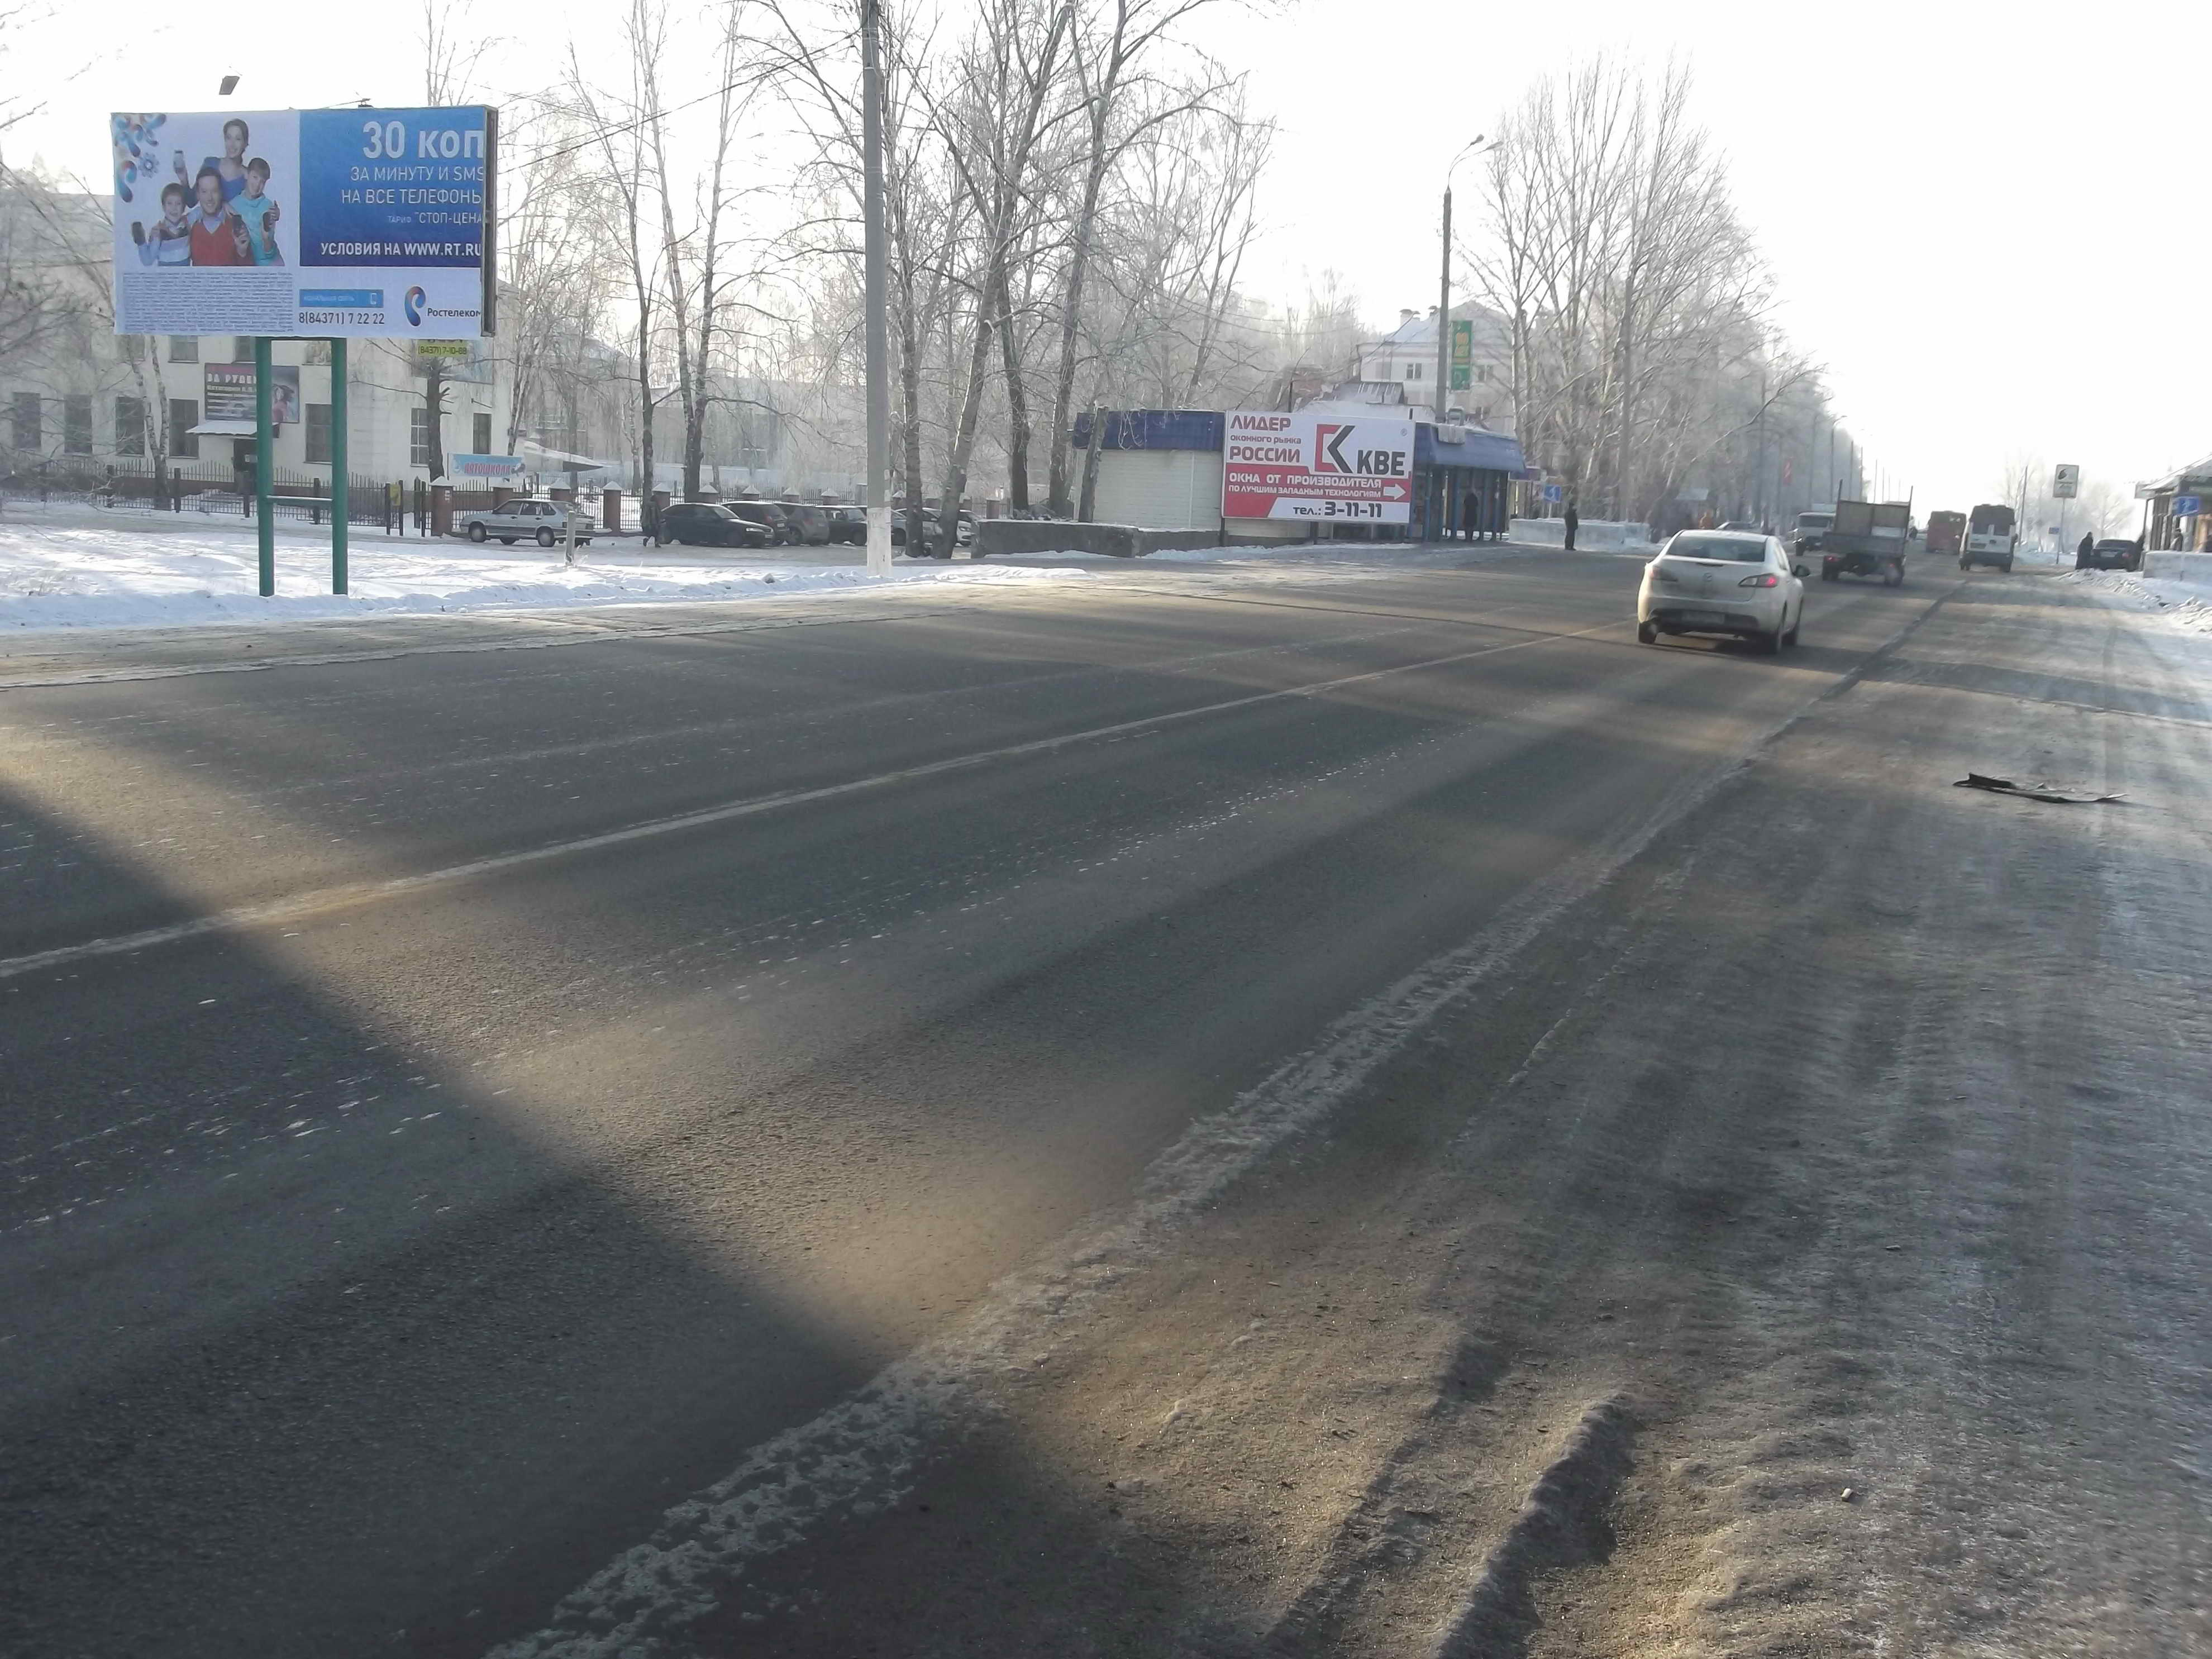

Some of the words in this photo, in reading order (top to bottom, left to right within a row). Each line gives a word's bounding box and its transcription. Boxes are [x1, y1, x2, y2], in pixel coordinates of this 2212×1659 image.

[363, 121, 405, 159] 30
[351, 166, 369, 181] ЗА
[374, 166, 433, 181] МИНУТУ
[439, 167, 448, 180] И
[453, 166, 484, 181] SMS
[342, 189, 361, 203] НА
[366, 189, 395, 203] ВСЕ
[321, 242, 380, 255] УСЛОВИЯ
[384, 242, 401, 255] НА
[403, 243, 482, 256] WWW.RT.RU
[299, 312, 345, 325] 8(84371)
[349, 313, 354, 324] 7
[357, 313, 369, 324] 22
[373, 313, 385, 325] 22
[1230, 415, 1291, 431] ЛИДЕР
[1274, 436, 1302, 445] рынка
[1229, 446, 1300, 463] РОССИИ
[1229, 473, 1260, 483] ОКНА
[1266, 474, 1281, 484] ОТ
[1287, 475, 1381, 488] ПРОИЗВОДИТЕЛЯ
[1241, 485, 1277, 494] ЛУЧШИМ
[1278, 487, 1323, 496] ЗАПАДНЫМ
[1324, 489, 1381, 498] ТЕХНОЛОГИЯМ
[1324, 502, 1382, 517] 3-11-11
